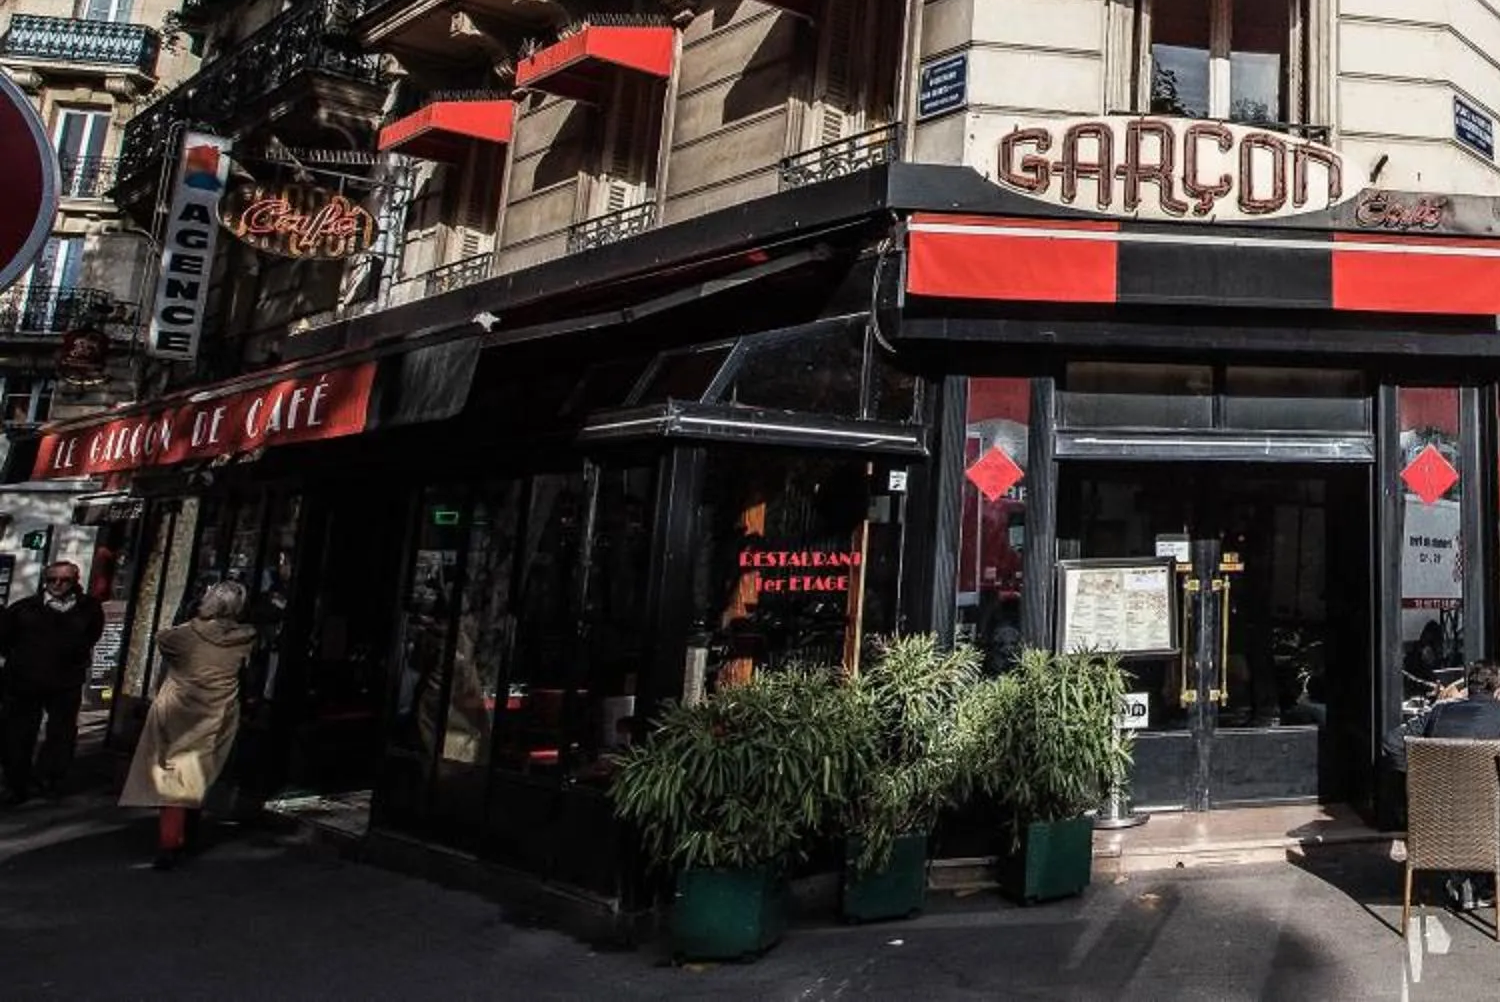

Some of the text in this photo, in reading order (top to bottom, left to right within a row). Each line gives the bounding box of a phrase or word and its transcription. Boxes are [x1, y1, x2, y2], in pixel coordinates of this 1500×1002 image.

[998, 119, 1343, 216] GARÇON
[156, 203, 211, 352] AGENCE
[53, 374, 330, 469] LE GARÇON DE CAFÉ
[739, 551, 861, 567] RESTAURANT
